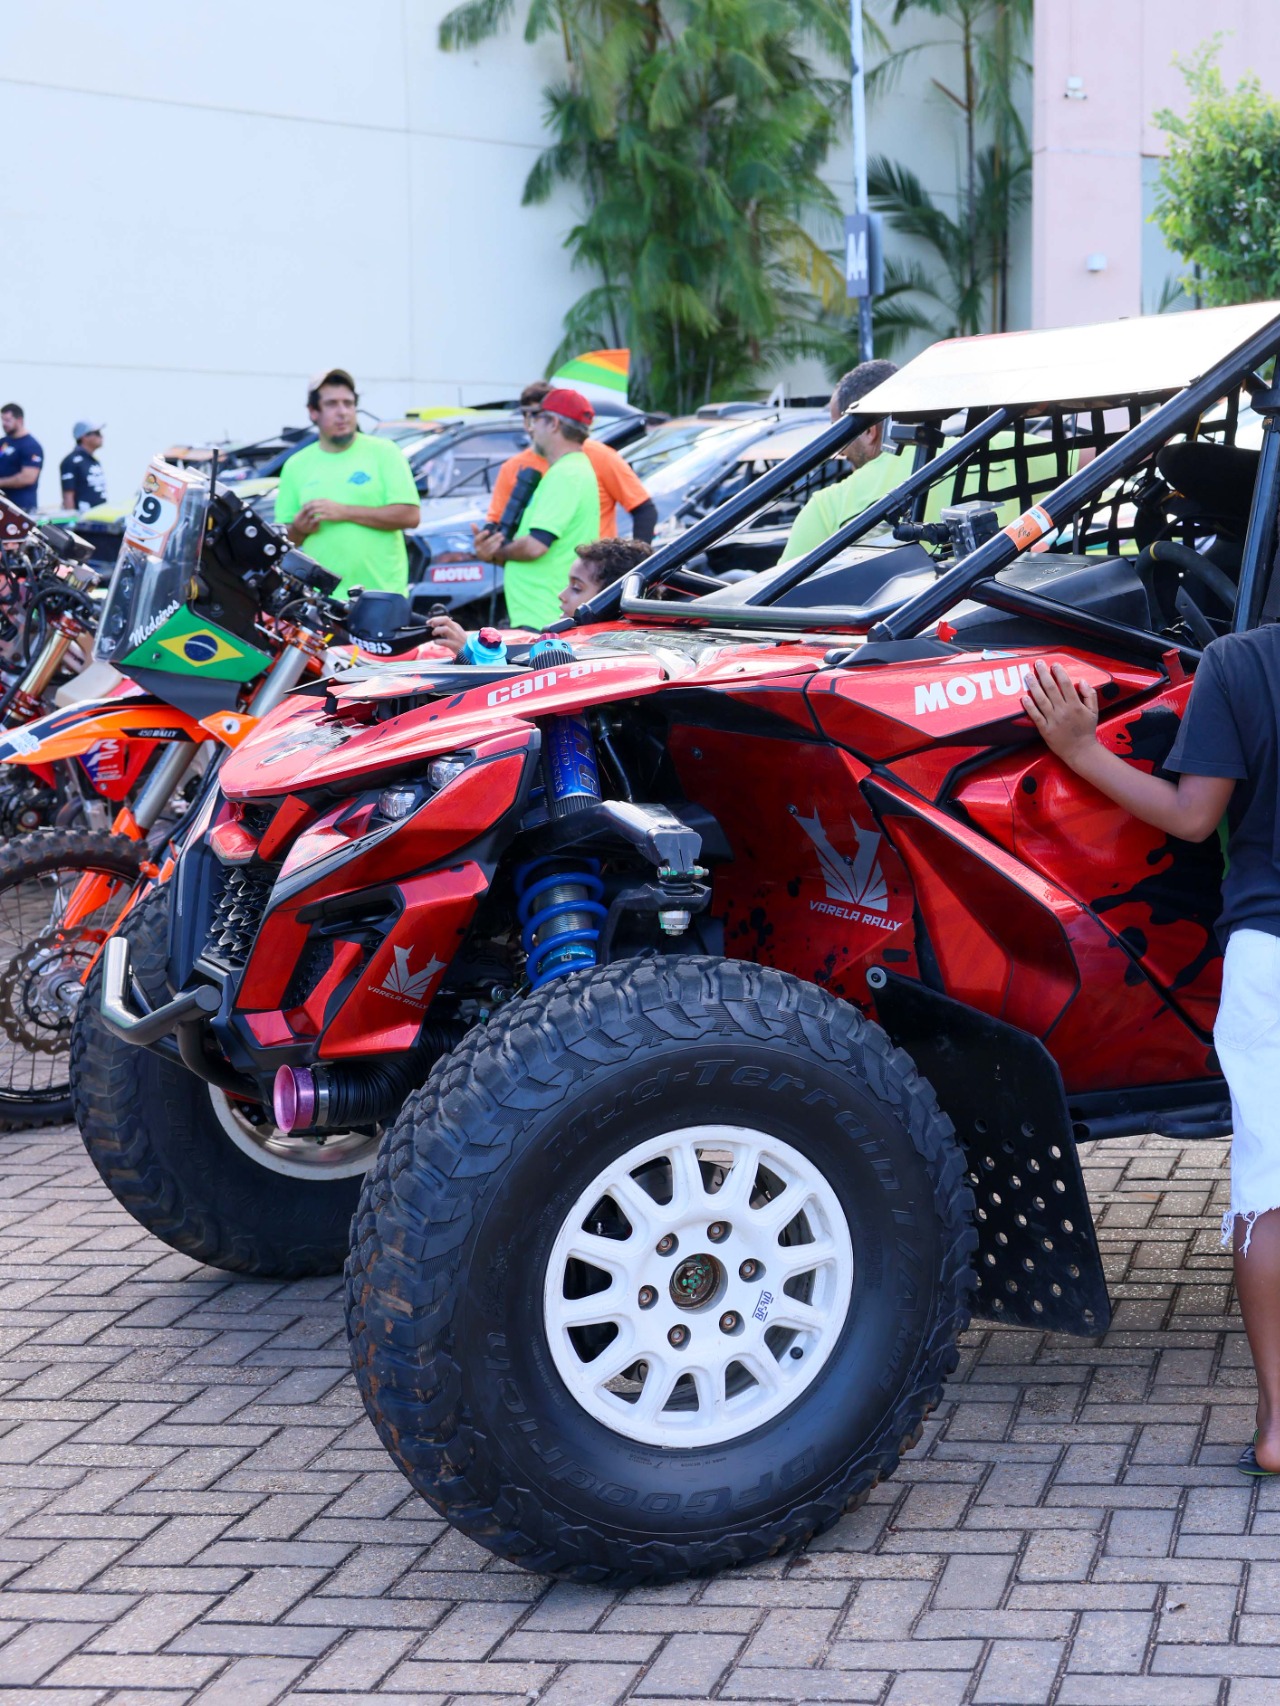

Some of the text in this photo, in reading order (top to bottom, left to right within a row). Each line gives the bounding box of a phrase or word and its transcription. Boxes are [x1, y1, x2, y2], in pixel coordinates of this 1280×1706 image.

[846, 230, 867, 281] A4
[433, 567, 482, 582] MOTUL
[129, 599, 180, 647] Medeiros
[809, 900, 903, 931] VARELA RALLY
[367, 985, 428, 1009] VARELA RALLY
[543, 1059, 900, 1191] Mud-Terrain
